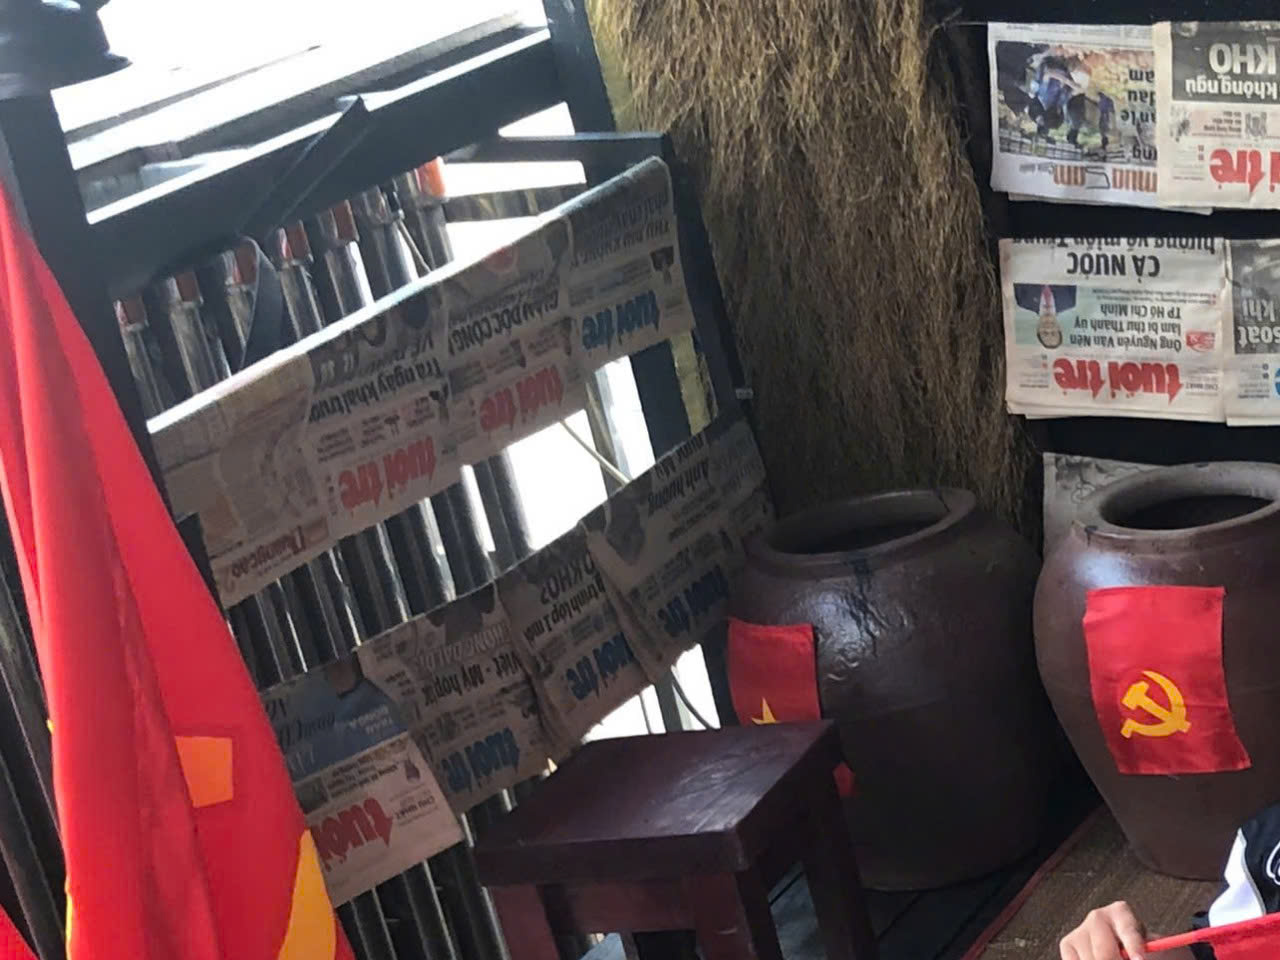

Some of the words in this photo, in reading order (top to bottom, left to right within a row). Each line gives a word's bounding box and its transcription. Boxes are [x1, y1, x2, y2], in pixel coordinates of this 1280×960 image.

[1185, 75, 1219, 97] ngủ
[1221, 76, 1278, 102] không
[1209, 149, 1265, 198] trẻ
[1067, 253, 1125, 279] NƯỚC
[1100, 303, 1128, 317] Minh
[1167, 306, 1182, 320] TP
[1053, 358, 1105, 400] trẻ
[1108, 362, 1184, 404] tuổi
